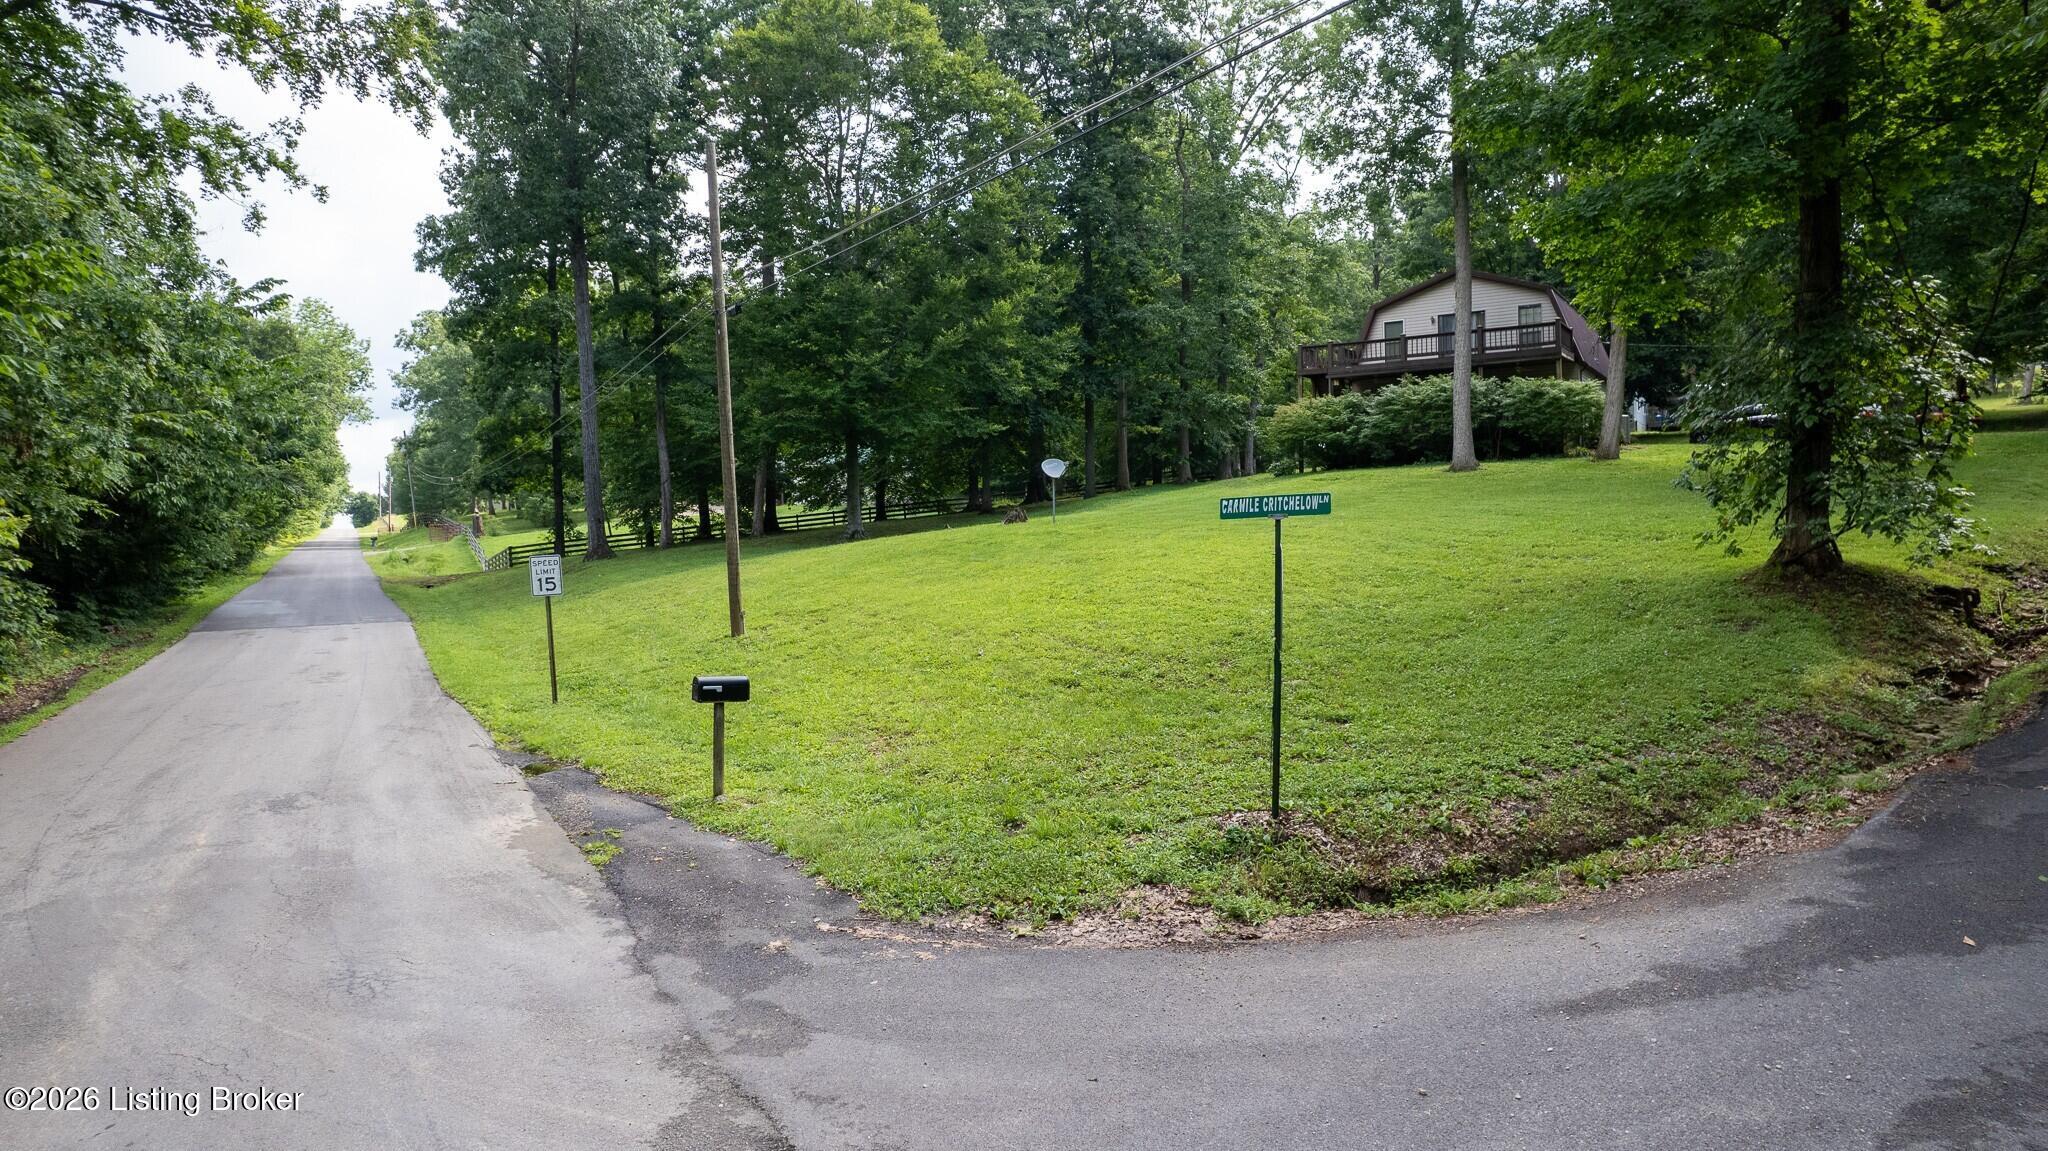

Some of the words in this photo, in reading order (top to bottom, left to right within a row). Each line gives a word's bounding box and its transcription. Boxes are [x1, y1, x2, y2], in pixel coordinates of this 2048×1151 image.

[1262, 495, 1319, 512] CRITCHELOW
[1319, 495, 1329, 503] LN
[532, 559, 559, 567] SPEED
[537, 577, 557, 592] 15
